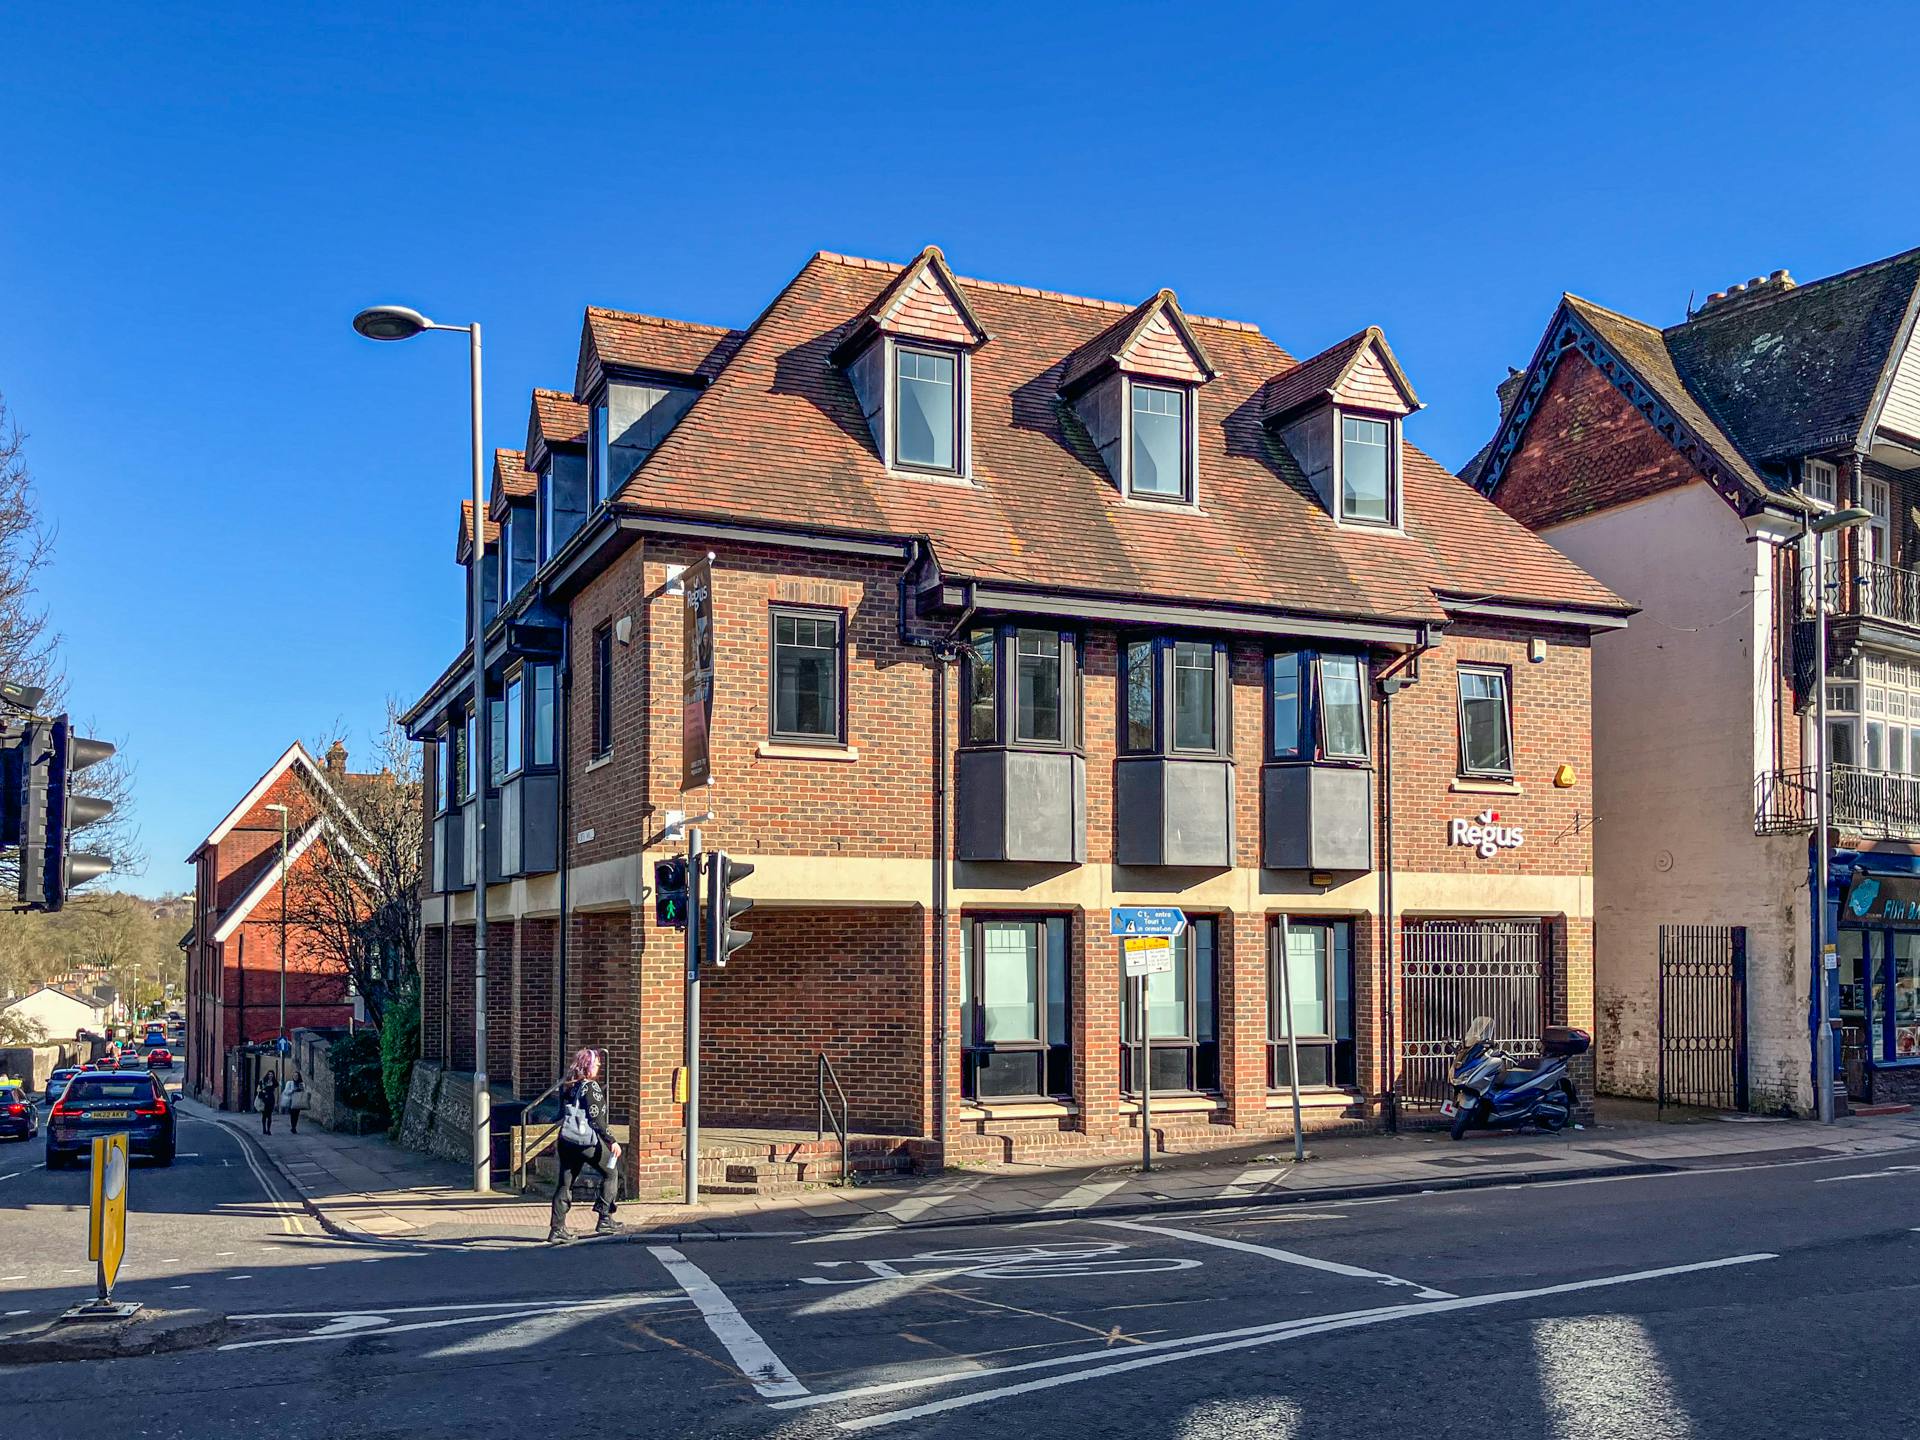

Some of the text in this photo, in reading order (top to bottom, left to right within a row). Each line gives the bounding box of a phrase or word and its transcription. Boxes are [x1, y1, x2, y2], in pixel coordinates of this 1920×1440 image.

[687, 586, 708, 612] Regus
[1452, 818, 1524, 857] Regus
[1884, 899, 1905, 920] FISH
